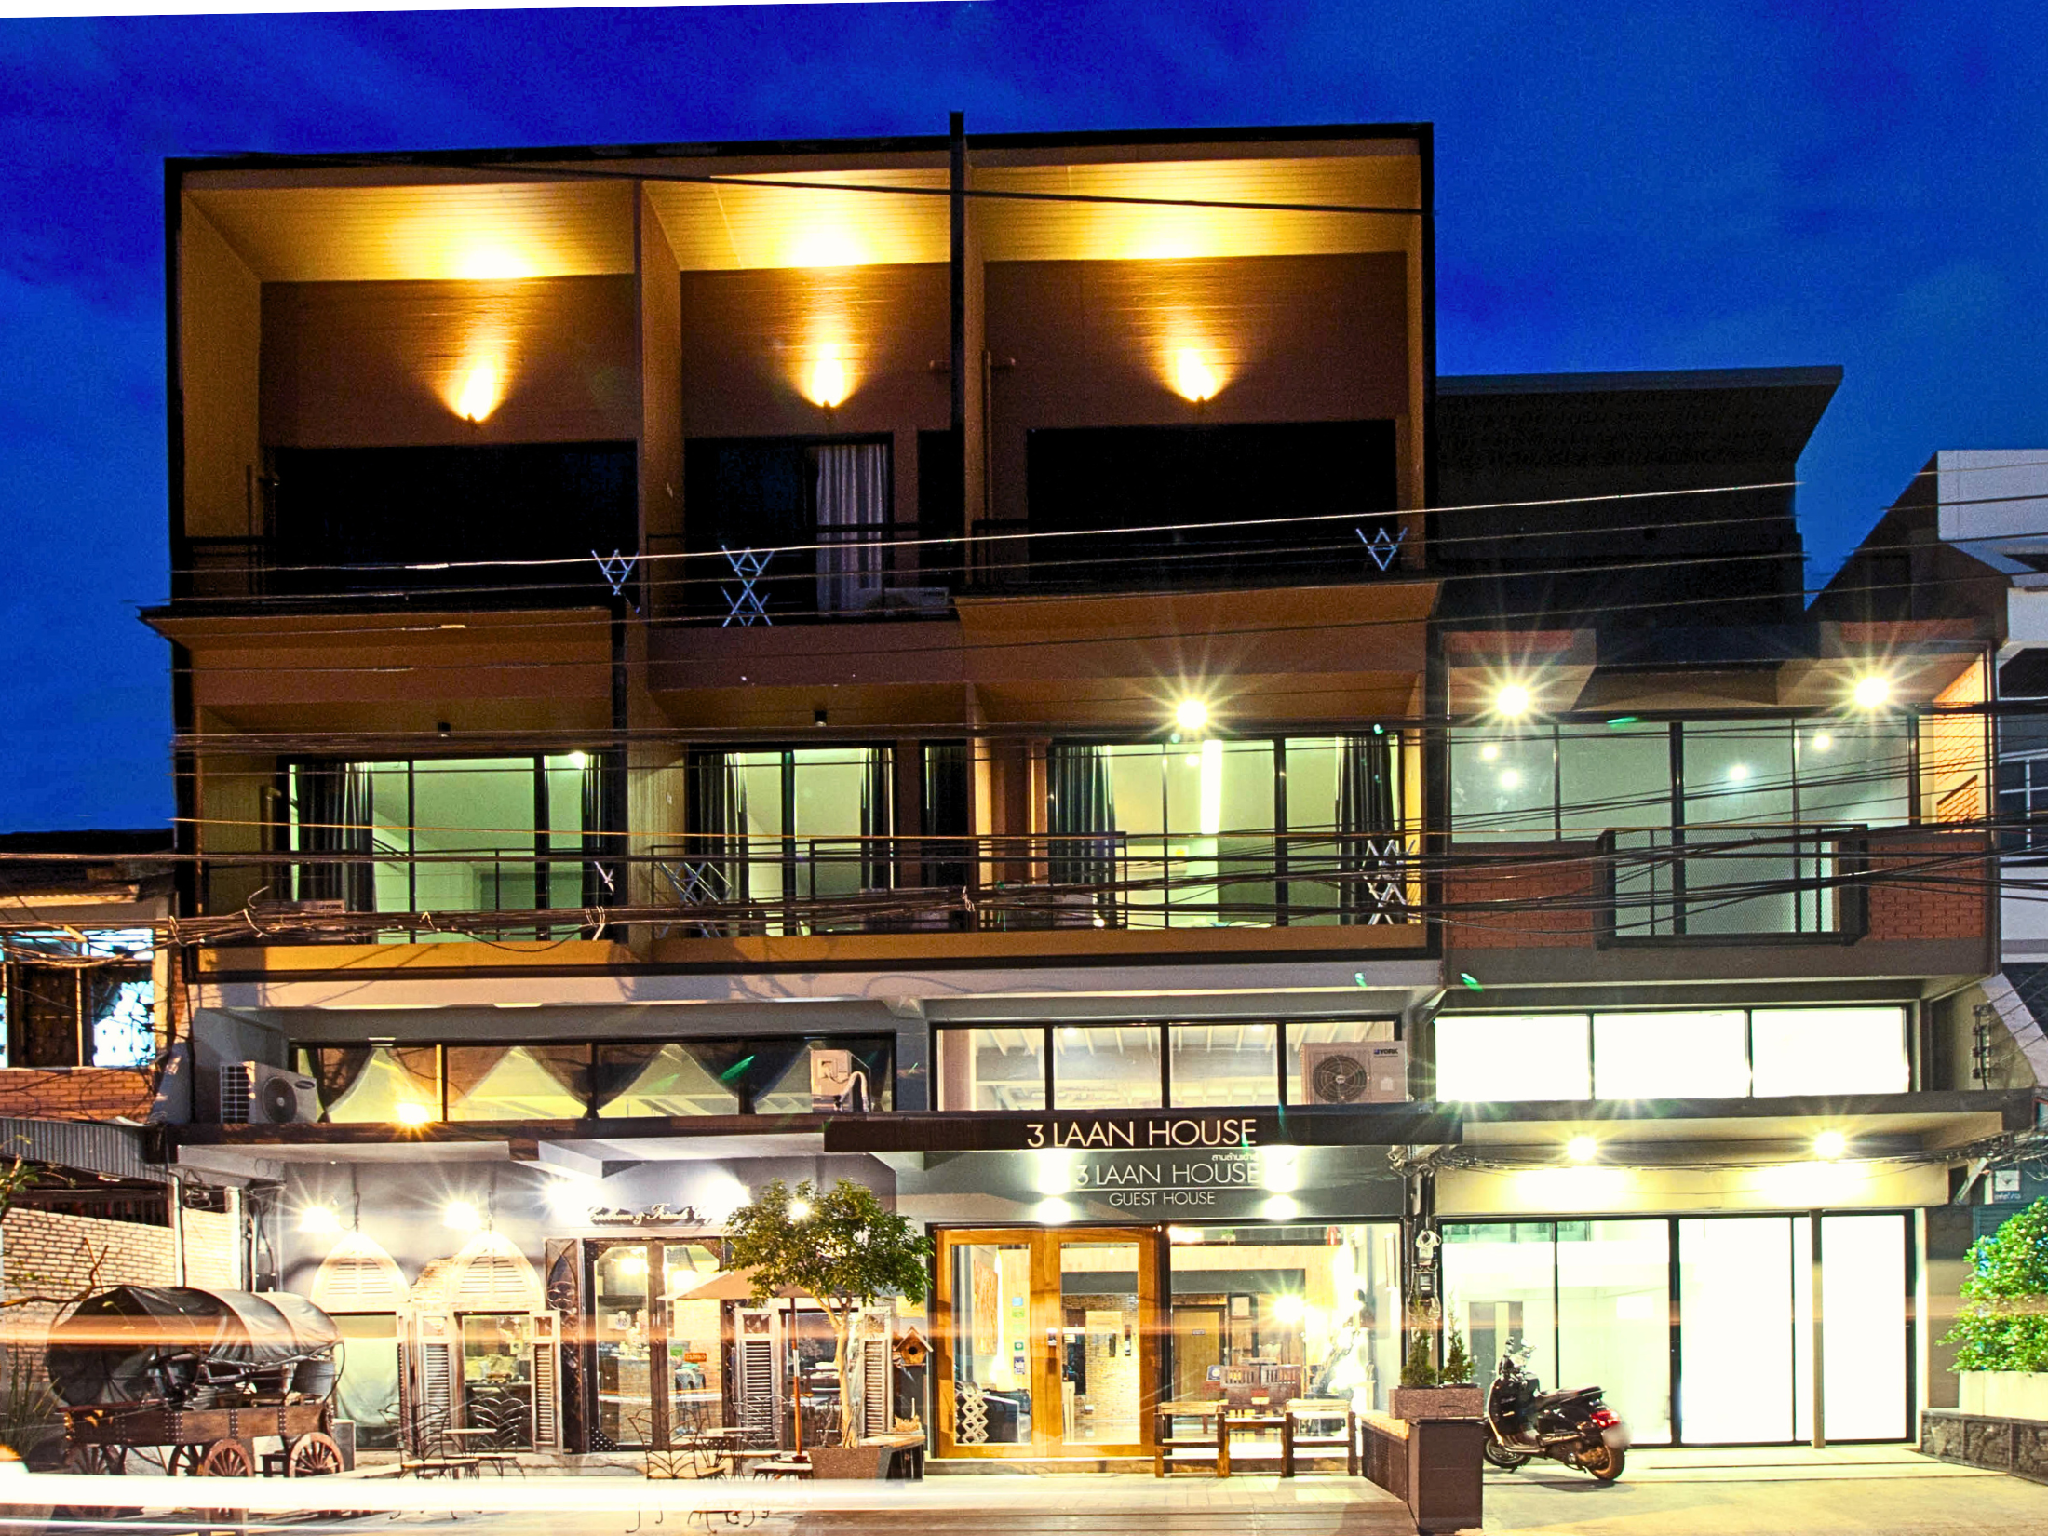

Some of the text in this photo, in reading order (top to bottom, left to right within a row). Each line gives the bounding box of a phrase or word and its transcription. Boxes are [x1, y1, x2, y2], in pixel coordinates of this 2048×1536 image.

[1026, 1119, 1257, 1148] 3 LAAN HOUSE
[1075, 1163, 1260, 1186] 3 LAAN HOUSE
[1109, 1191, 1216, 1206] GUEST HOUSE
